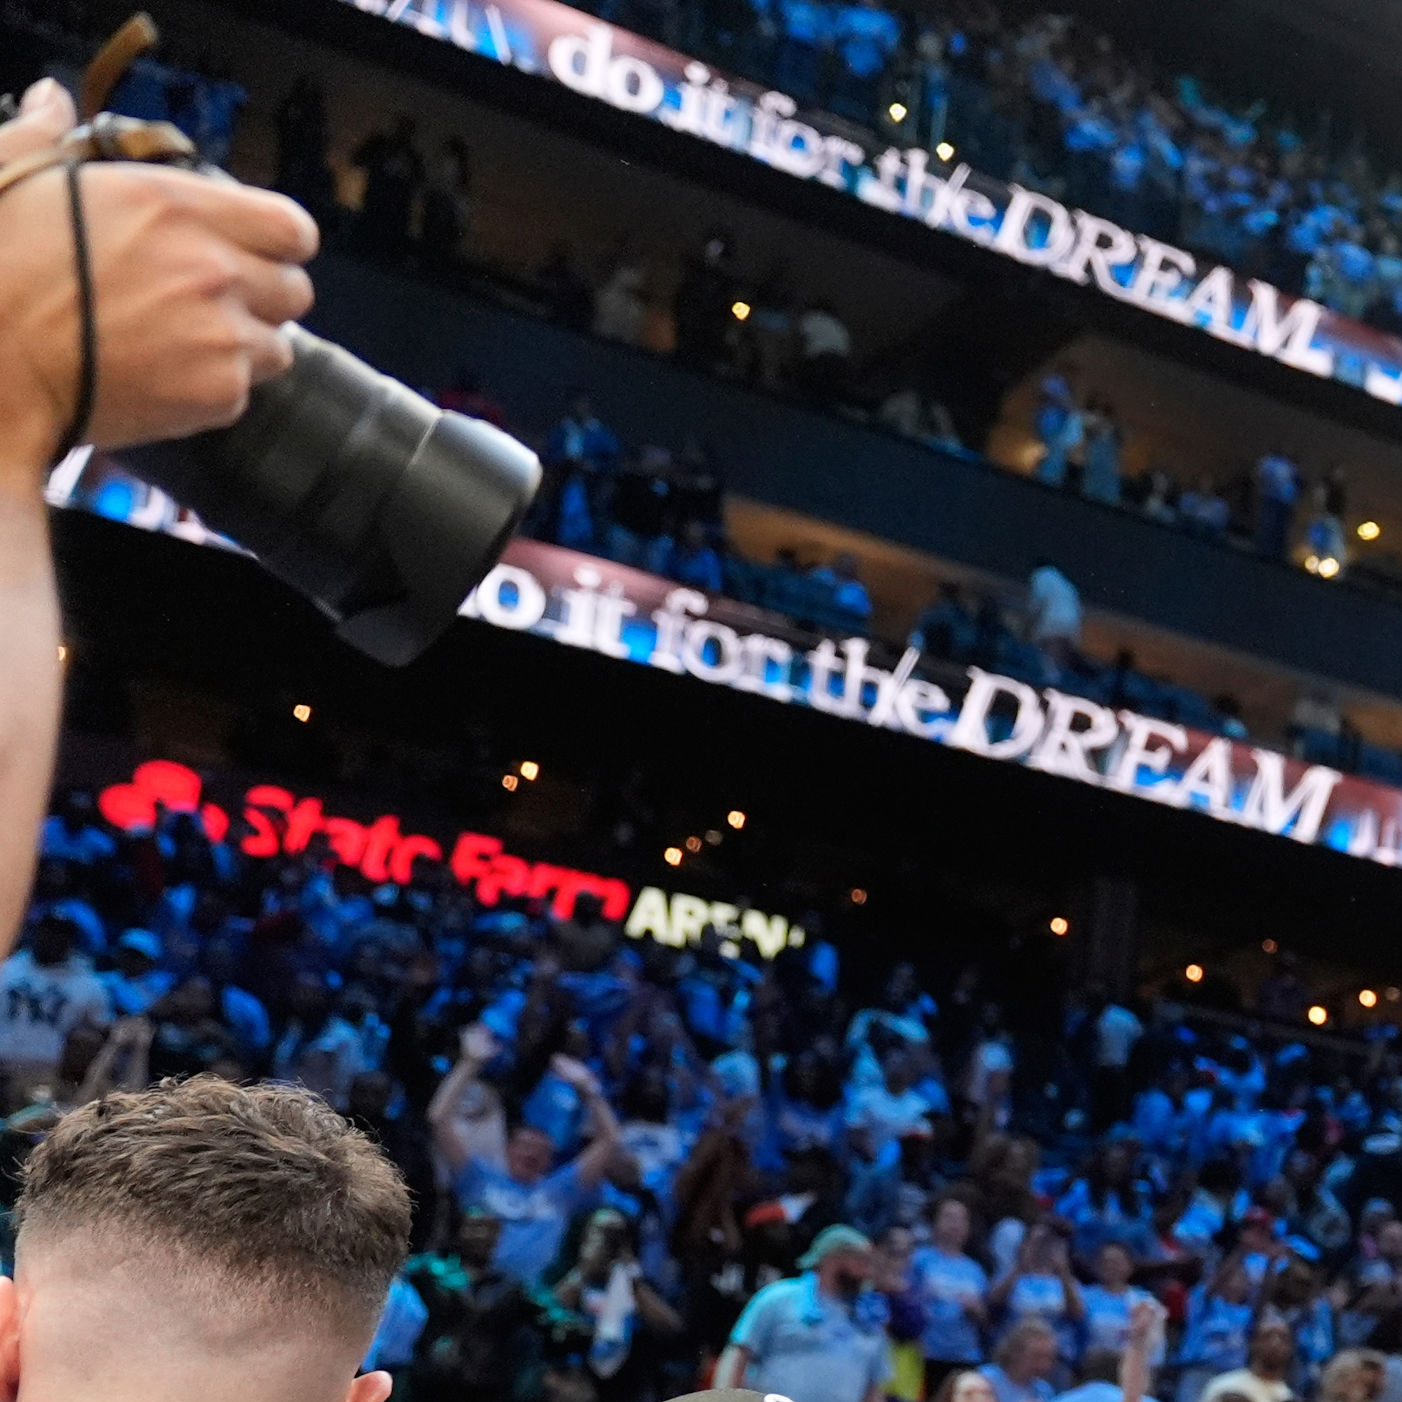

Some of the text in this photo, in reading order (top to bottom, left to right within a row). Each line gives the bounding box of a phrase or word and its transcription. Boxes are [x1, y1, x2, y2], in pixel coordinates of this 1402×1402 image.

[548, 22, 1335, 377] do it for the DREAM
[457, 563, 1343, 844] o it for the DREAM
[625, 886, 806, 961] AREN
